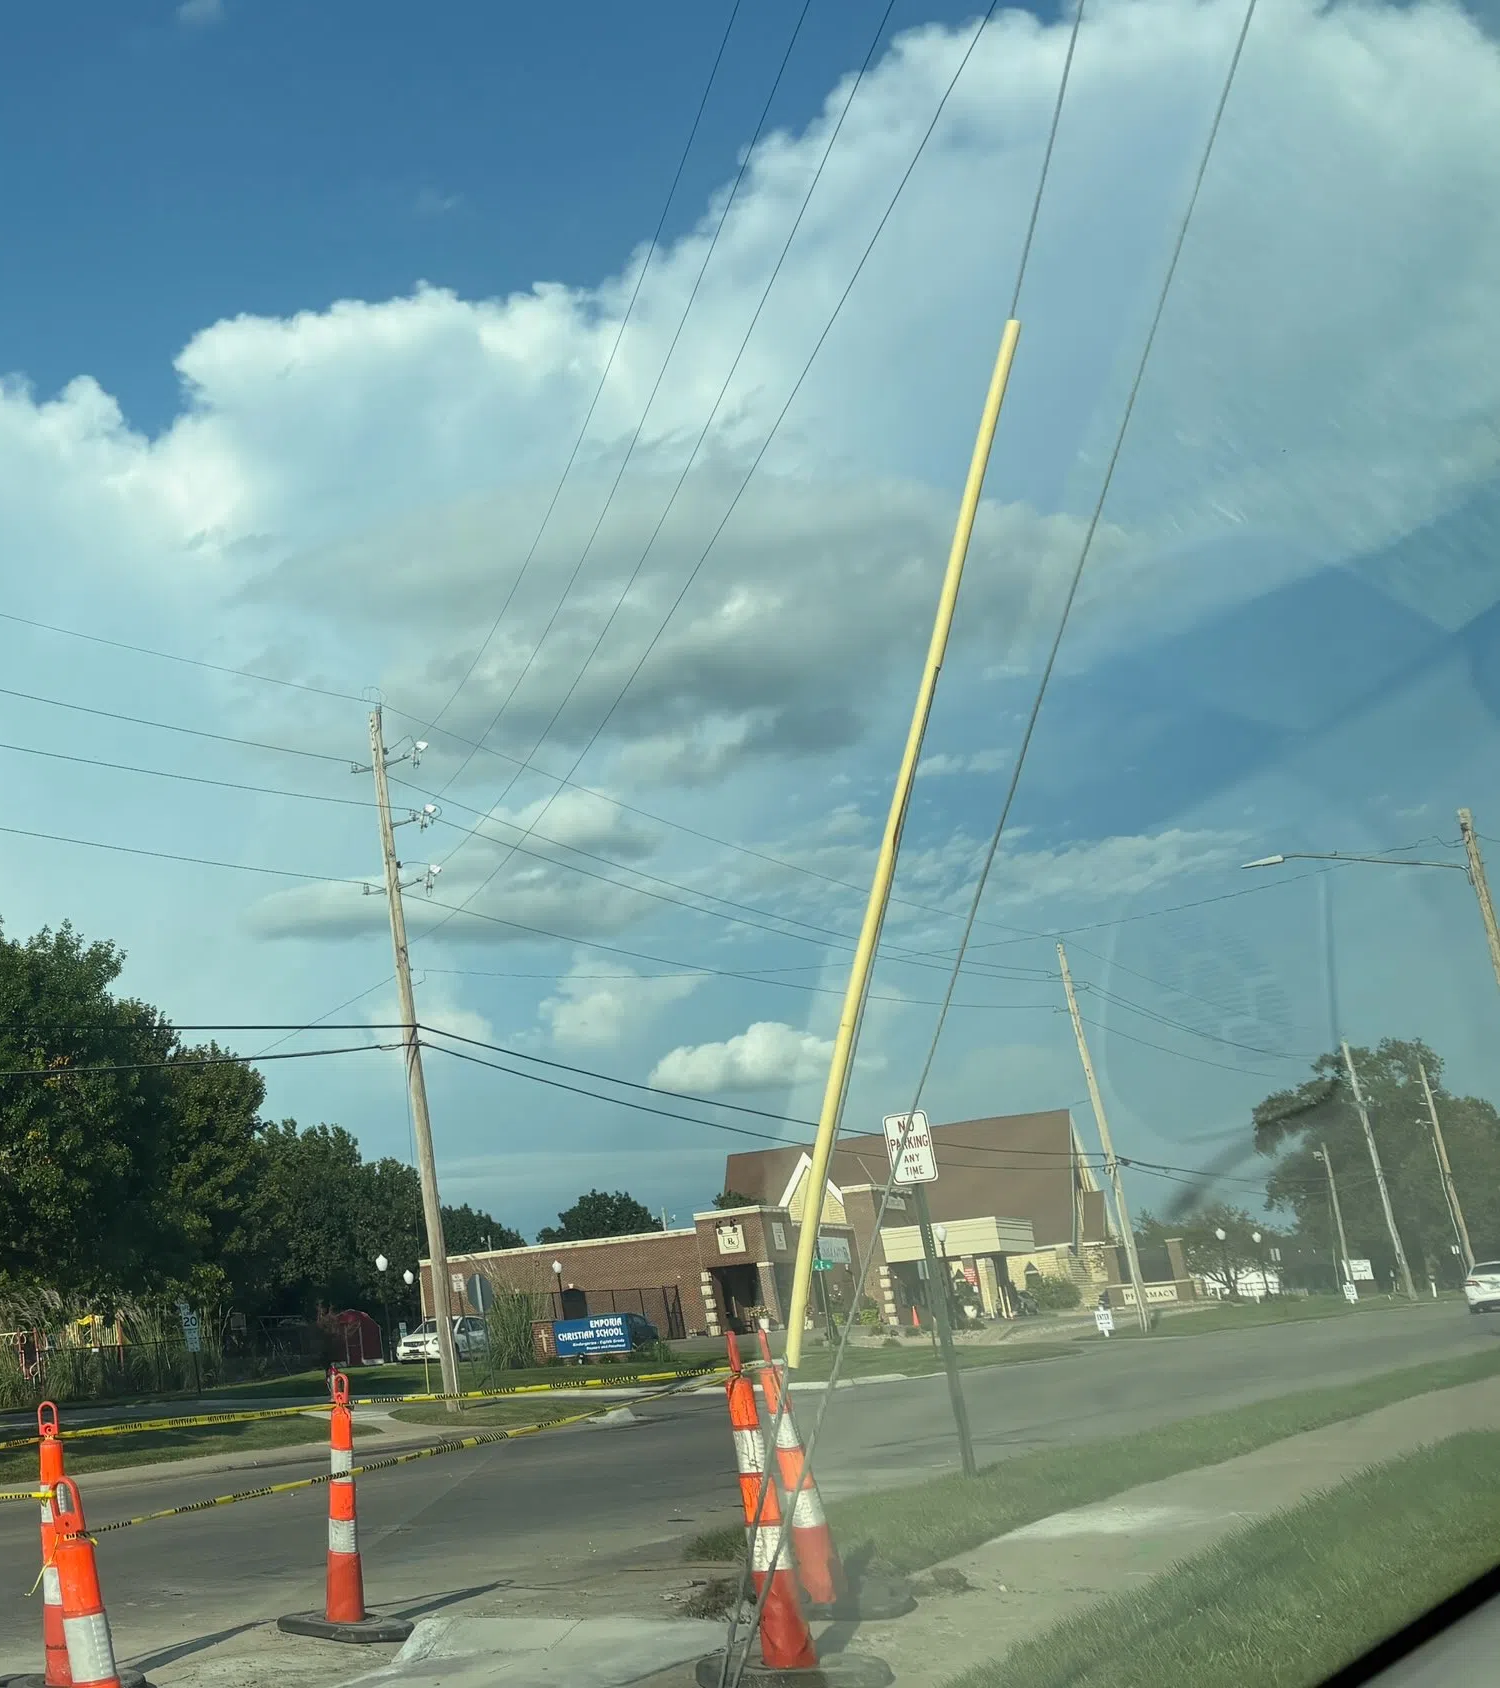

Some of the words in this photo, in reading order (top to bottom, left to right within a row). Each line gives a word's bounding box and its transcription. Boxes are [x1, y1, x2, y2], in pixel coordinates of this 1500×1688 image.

[897, 1119, 915, 1133] NO
[889, 1134, 929, 1152] PARKING
[904, 1153, 920, 1164] ANY
[904, 1165, 925, 1177] TIME
[1125, 1289, 1175, 1300] PHMACY
[183, 1316, 197, 1327] 20
[590, 1317, 622, 1328] EMPORIA
[558, 1330, 594, 1341] CHRISTIAN
[596, 1328, 624, 1337] SCHOOL
